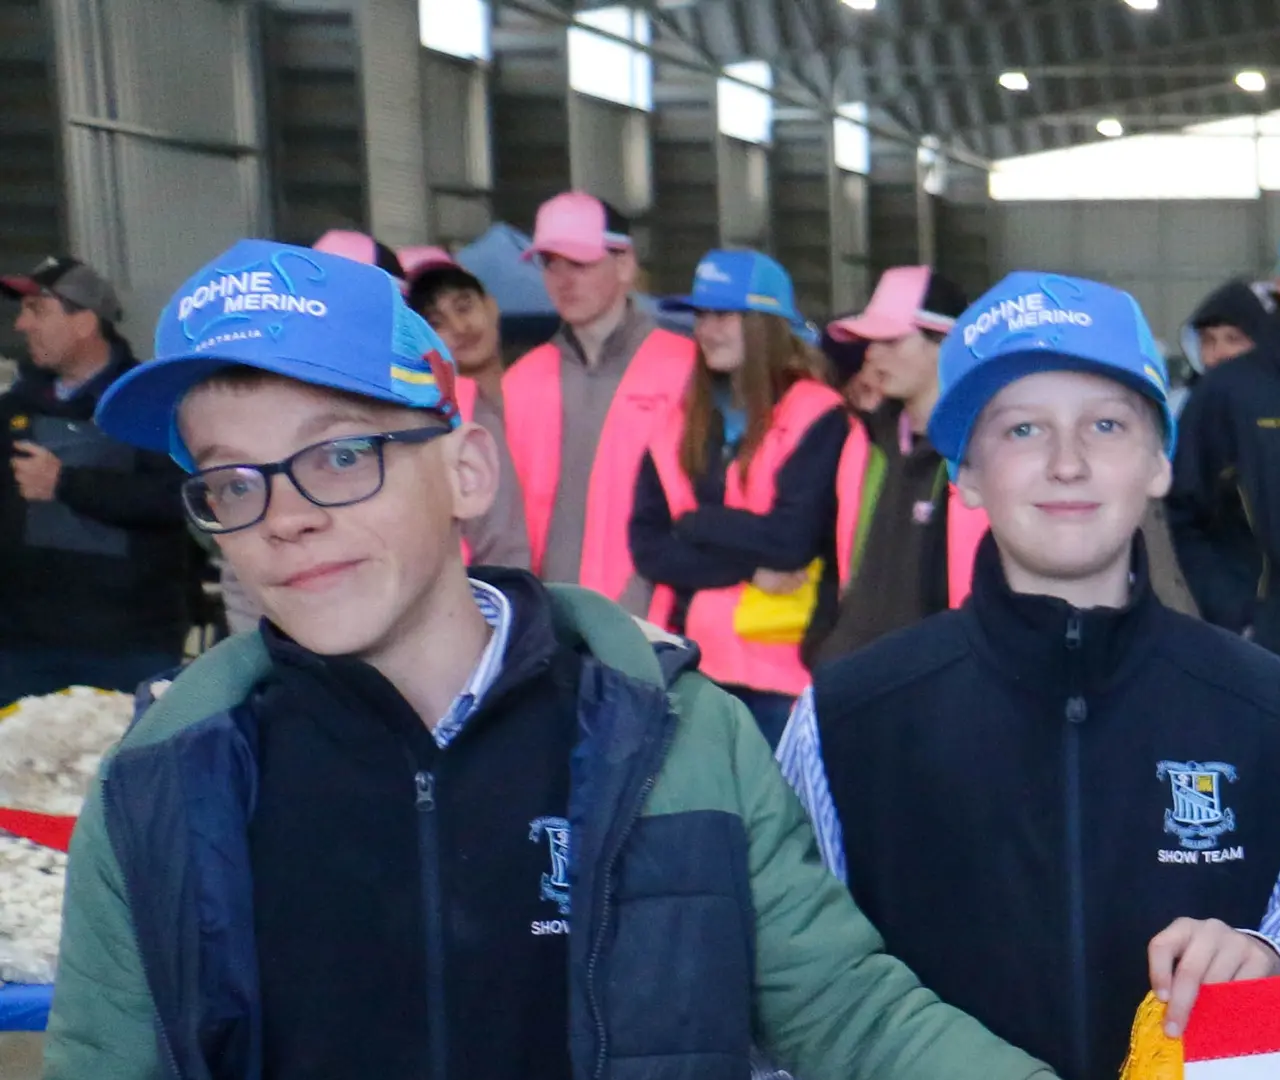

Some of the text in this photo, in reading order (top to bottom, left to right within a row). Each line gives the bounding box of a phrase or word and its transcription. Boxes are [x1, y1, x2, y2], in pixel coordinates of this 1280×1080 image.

[177, 271, 273, 321] DOHNE
[223, 293, 328, 317] MERINO
[963, 293, 1044, 346] DOHNE
[1008, 308, 1093, 332] MERINO
[1157, 846, 1245, 864] SHOW TEAM
